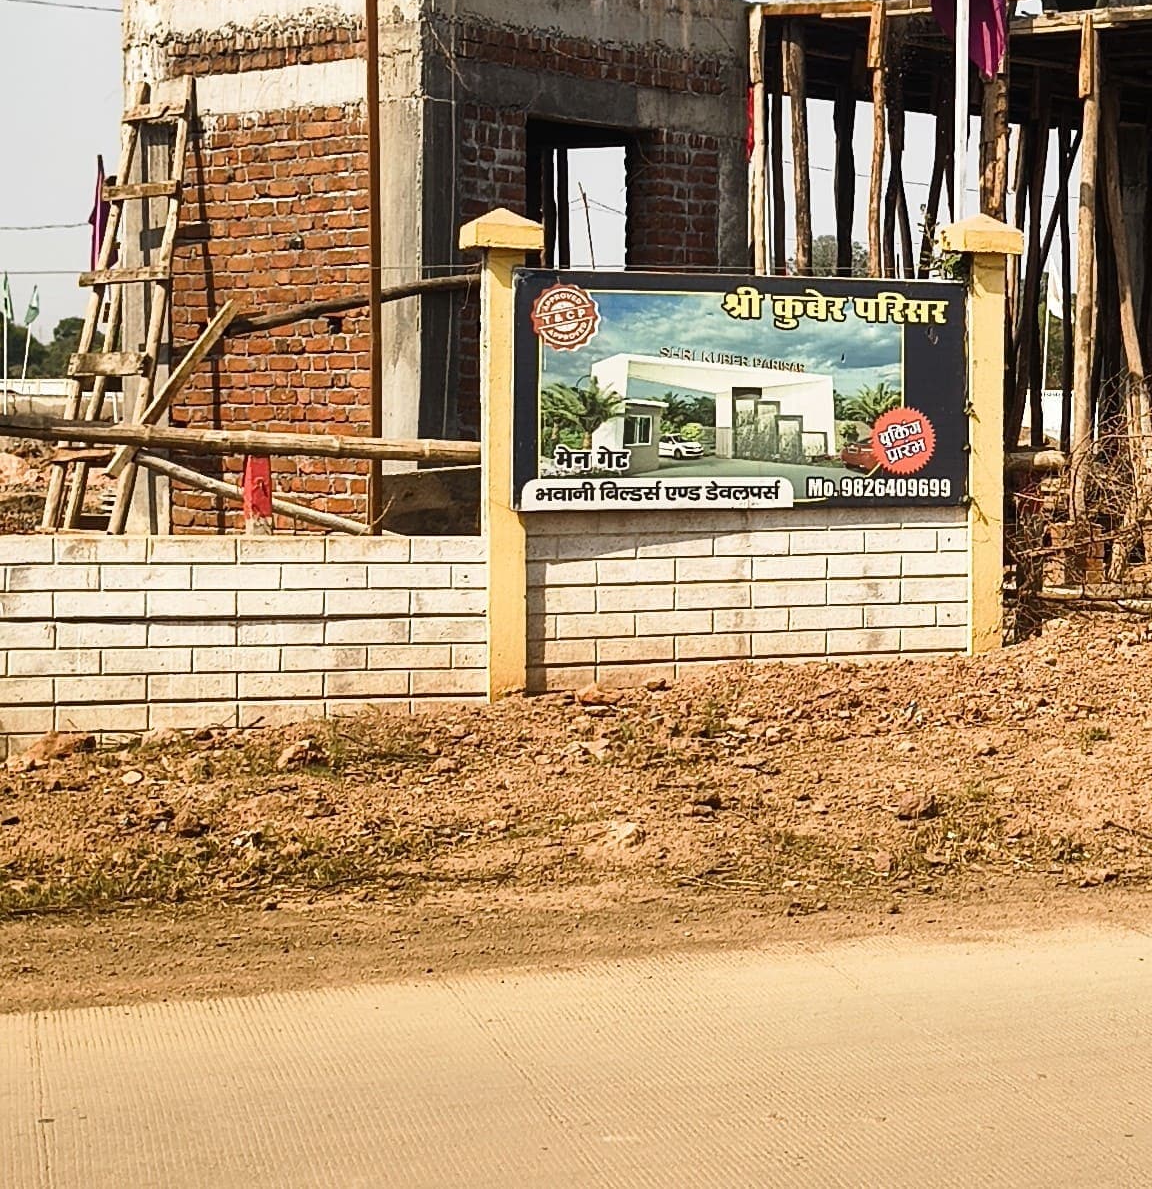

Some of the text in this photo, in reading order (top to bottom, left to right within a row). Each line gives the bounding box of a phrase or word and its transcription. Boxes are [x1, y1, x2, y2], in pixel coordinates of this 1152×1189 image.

[541, 293, 582, 311] APPROVED
[723, 287, 948, 329] श्री कुबेर परिसर
[660, 347, 695, 361] SHRI
[702, 351, 748, 367] KUBER
[556, 446, 629, 468] मेन गेट
[885, 438, 926, 463] प्रारंभ
[535, 481, 595, 501] भवानी
[665, 485, 702, 501] एण्ड
[705, 480, 780, 501] डेवलपर्स
